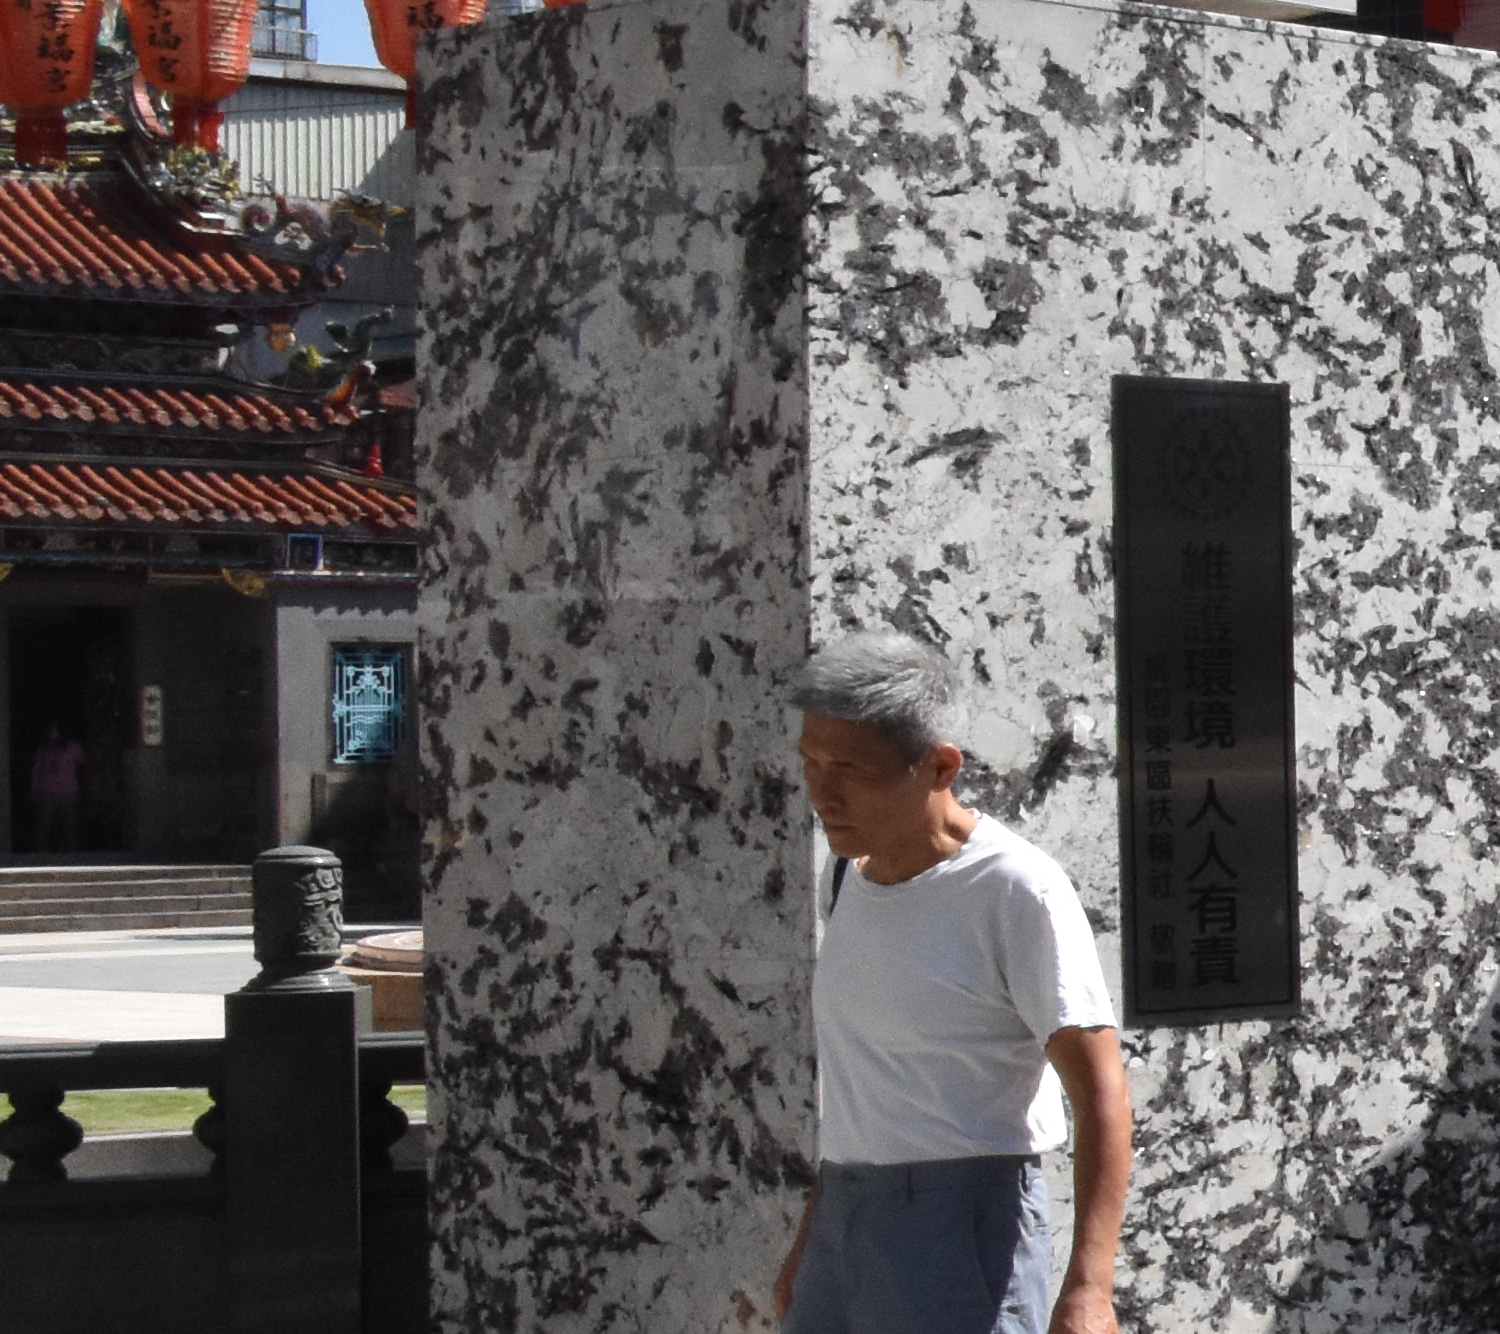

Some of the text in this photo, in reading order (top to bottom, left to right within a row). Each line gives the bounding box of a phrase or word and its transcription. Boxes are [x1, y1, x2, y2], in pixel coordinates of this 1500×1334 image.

[1182, 541, 1235, 750] 維護環境
[1186, 778, 1239, 987] 人人有責
